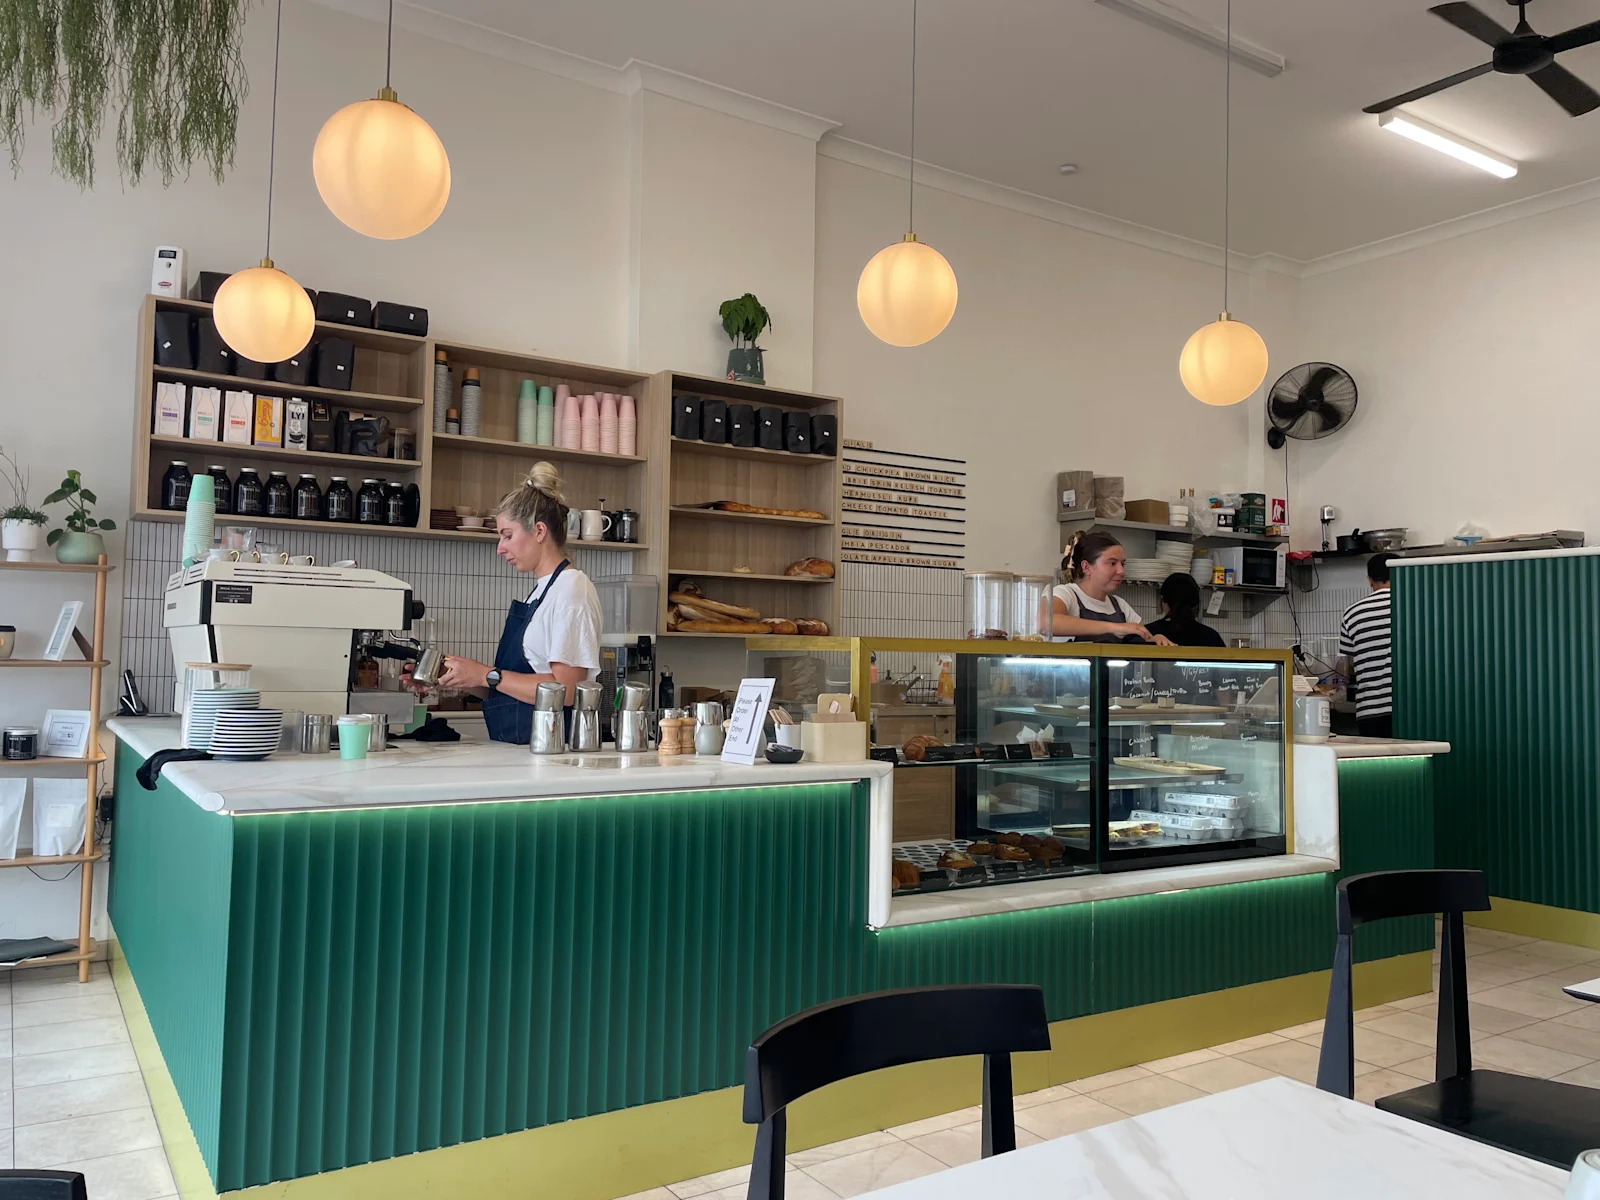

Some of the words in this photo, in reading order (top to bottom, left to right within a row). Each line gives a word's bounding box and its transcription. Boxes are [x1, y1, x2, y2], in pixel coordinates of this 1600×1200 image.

[856, 466, 900, 476] CHICKPEA
[905, 472, 931, 480] BROWN
[934, 475, 955, 483] RICE
[895, 483, 924, 492] RELISH
[929, 487, 962, 496] TOASTIE
[913, 509, 947, 518] TOASTIE
[865, 530, 902, 539] ORIGIN
[870, 543, 910, 551] PESCADOR
[739, 697, 753, 705] Please
